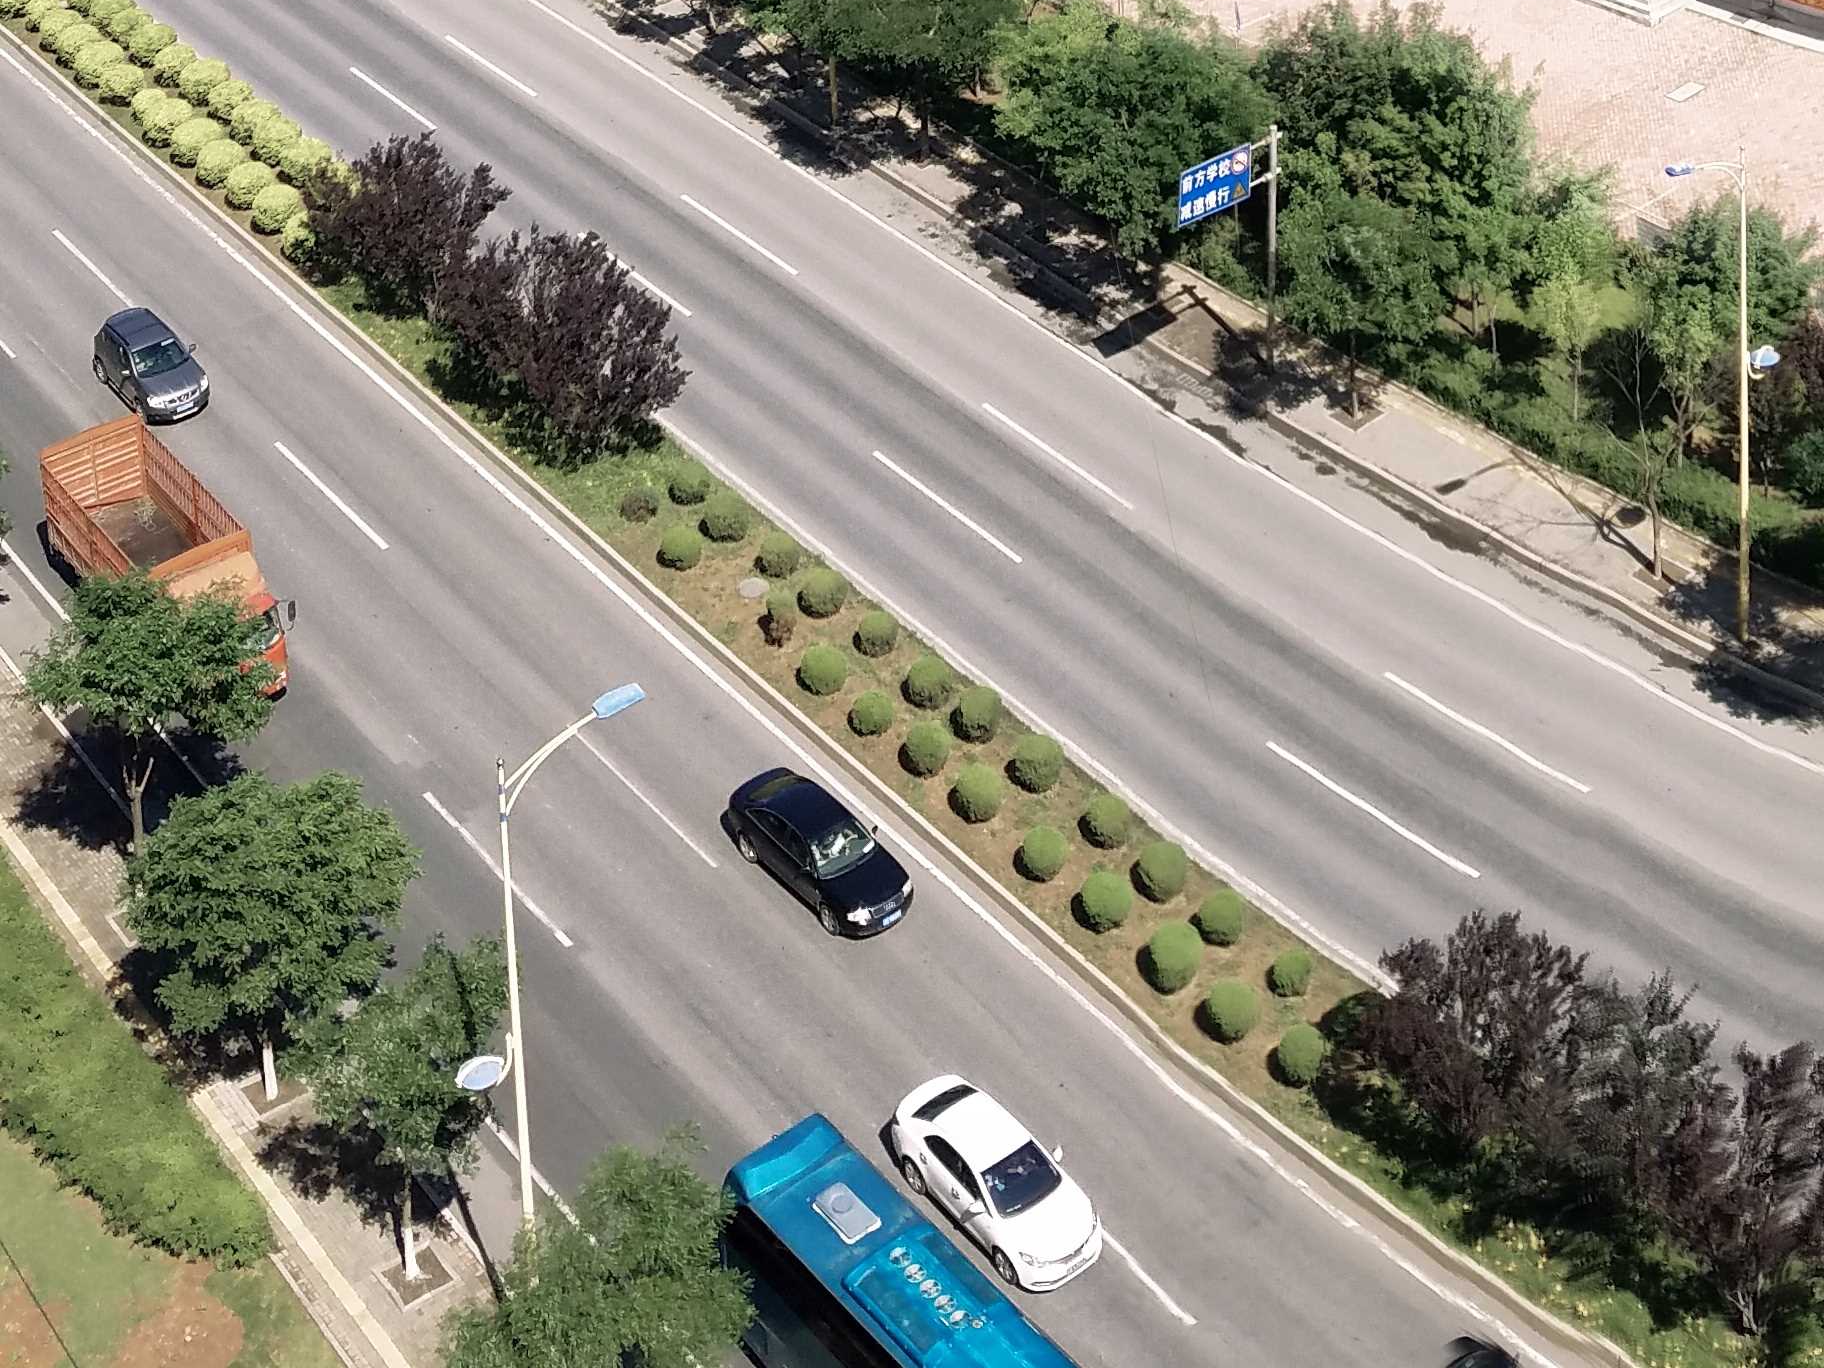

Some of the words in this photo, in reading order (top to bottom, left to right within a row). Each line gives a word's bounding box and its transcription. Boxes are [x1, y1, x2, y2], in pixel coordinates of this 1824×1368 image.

[1182, 158, 1231, 195] 前方学校
[1180, 186, 1230, 221] 减速慢行
